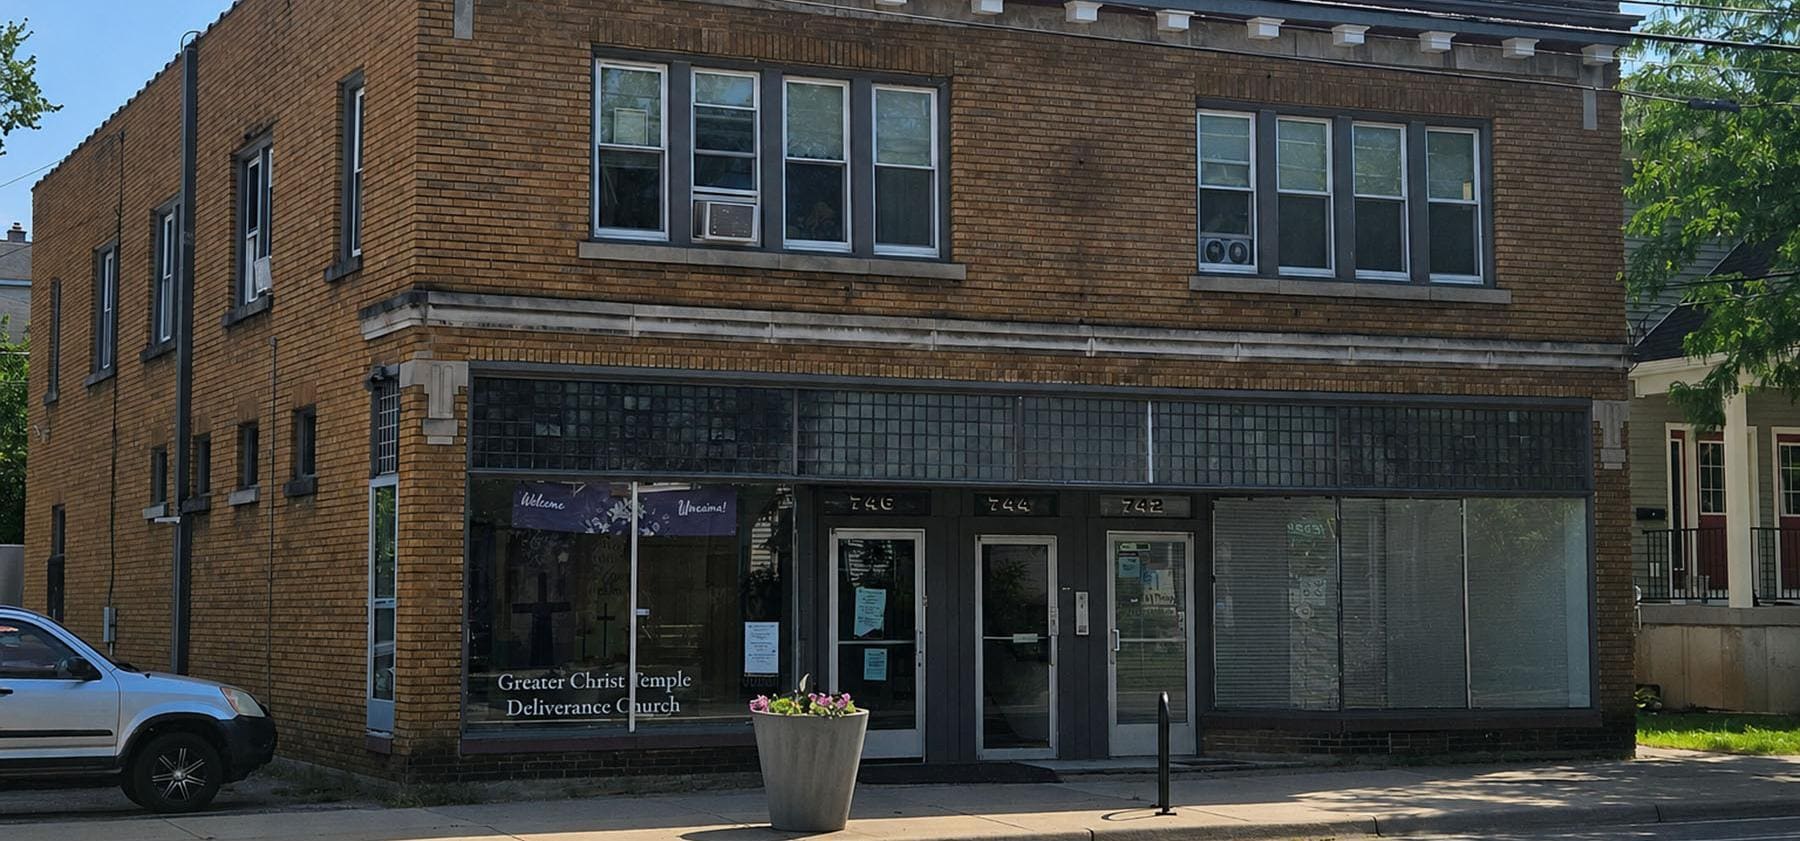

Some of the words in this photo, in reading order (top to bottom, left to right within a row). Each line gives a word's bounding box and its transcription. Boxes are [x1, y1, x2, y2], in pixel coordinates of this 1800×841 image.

[521, 492, 565, 511] Welcome
[850, 496, 894, 511] 746
[988, 496, 1031, 512] 744
[1121, 498, 1164, 513] 742
[498, 673, 565, 690] Greater
[570, 672, 625, 689] Christ
[634, 670, 691, 693] Temple
[506, 698, 611, 716] Deliverance
